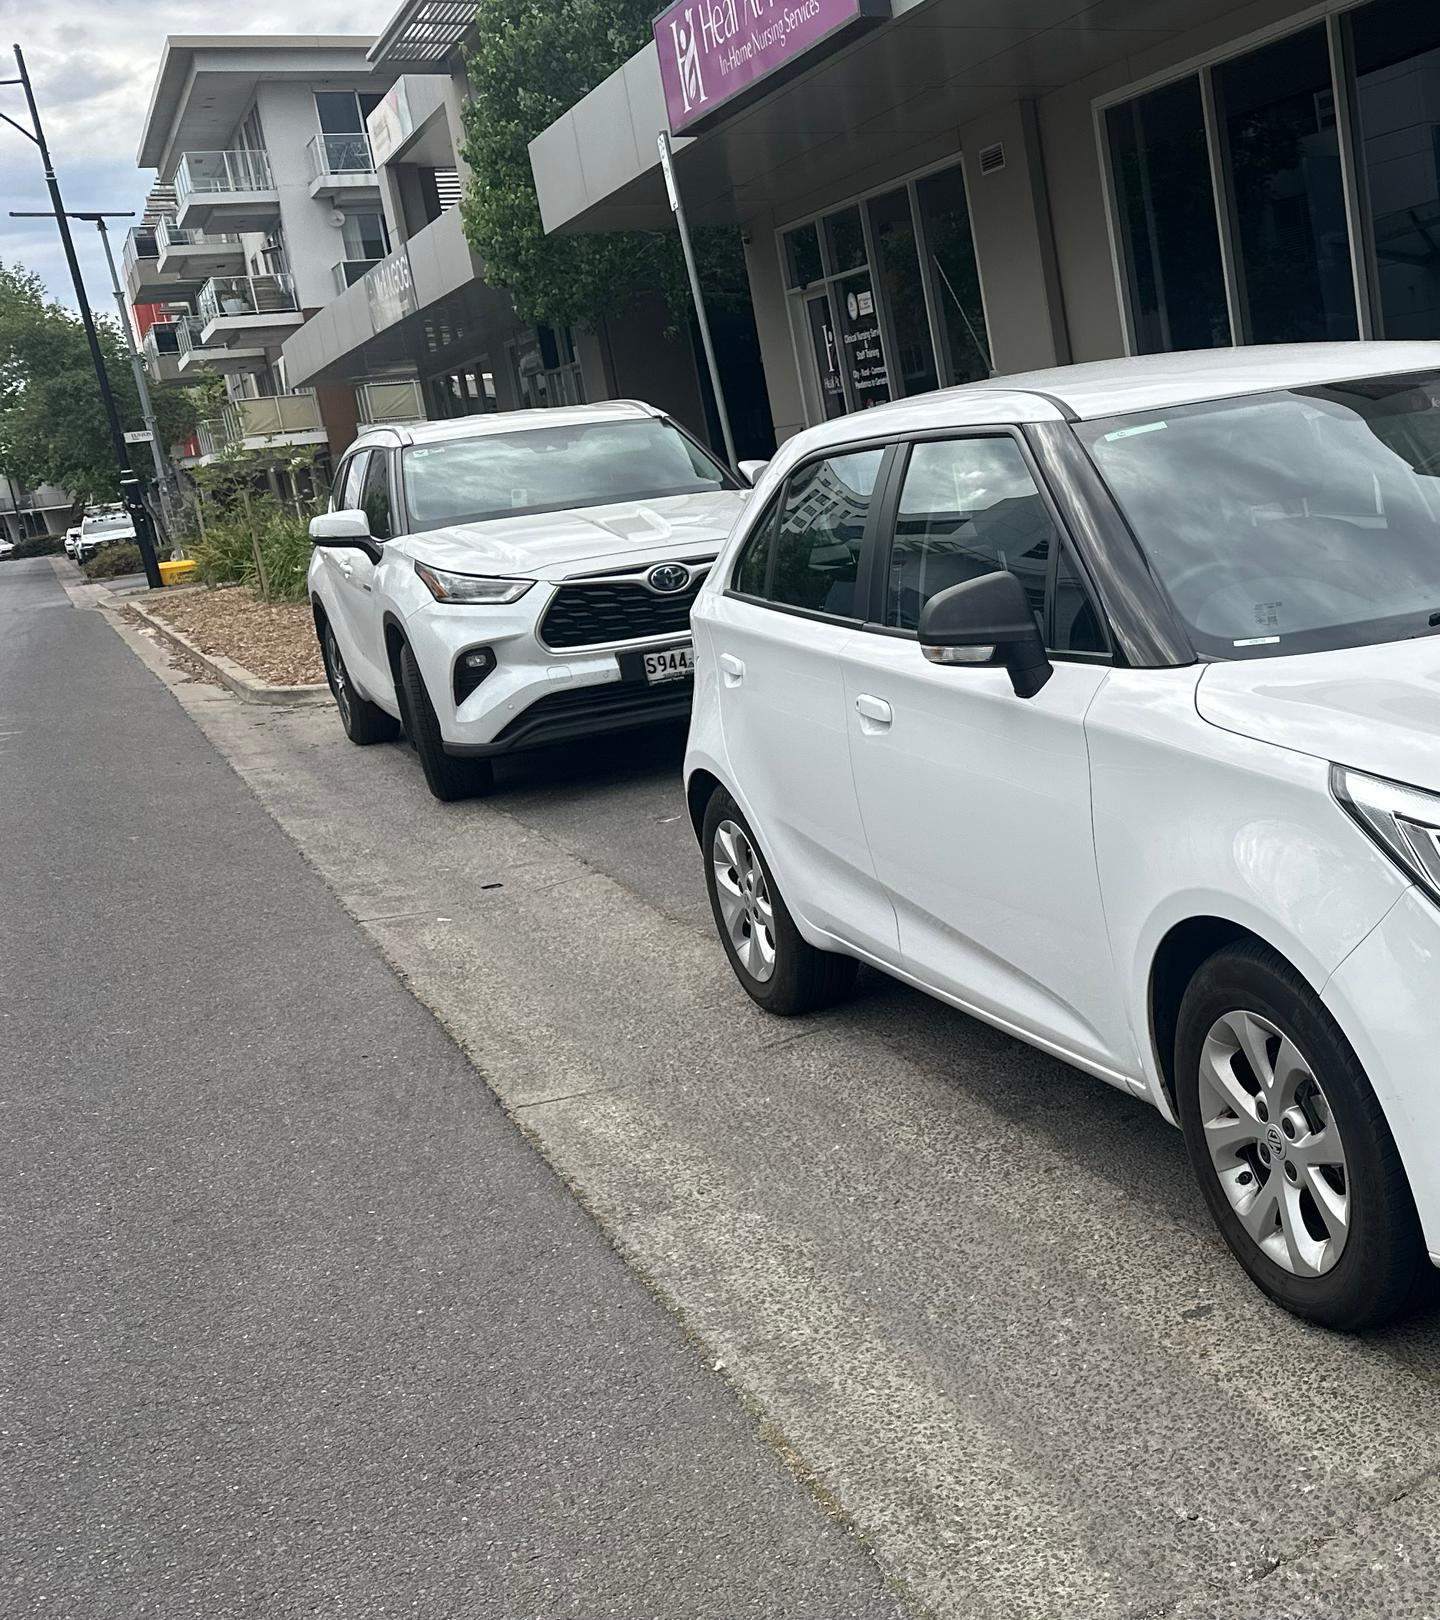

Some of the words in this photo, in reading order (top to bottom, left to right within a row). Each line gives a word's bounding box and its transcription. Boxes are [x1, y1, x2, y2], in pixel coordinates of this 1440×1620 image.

[698, 0, 739, 54] Heal
[719, 43, 753, 76] In-Home
[751, 19, 786, 54] Nursing
[783, 0, 820, 33] Services
